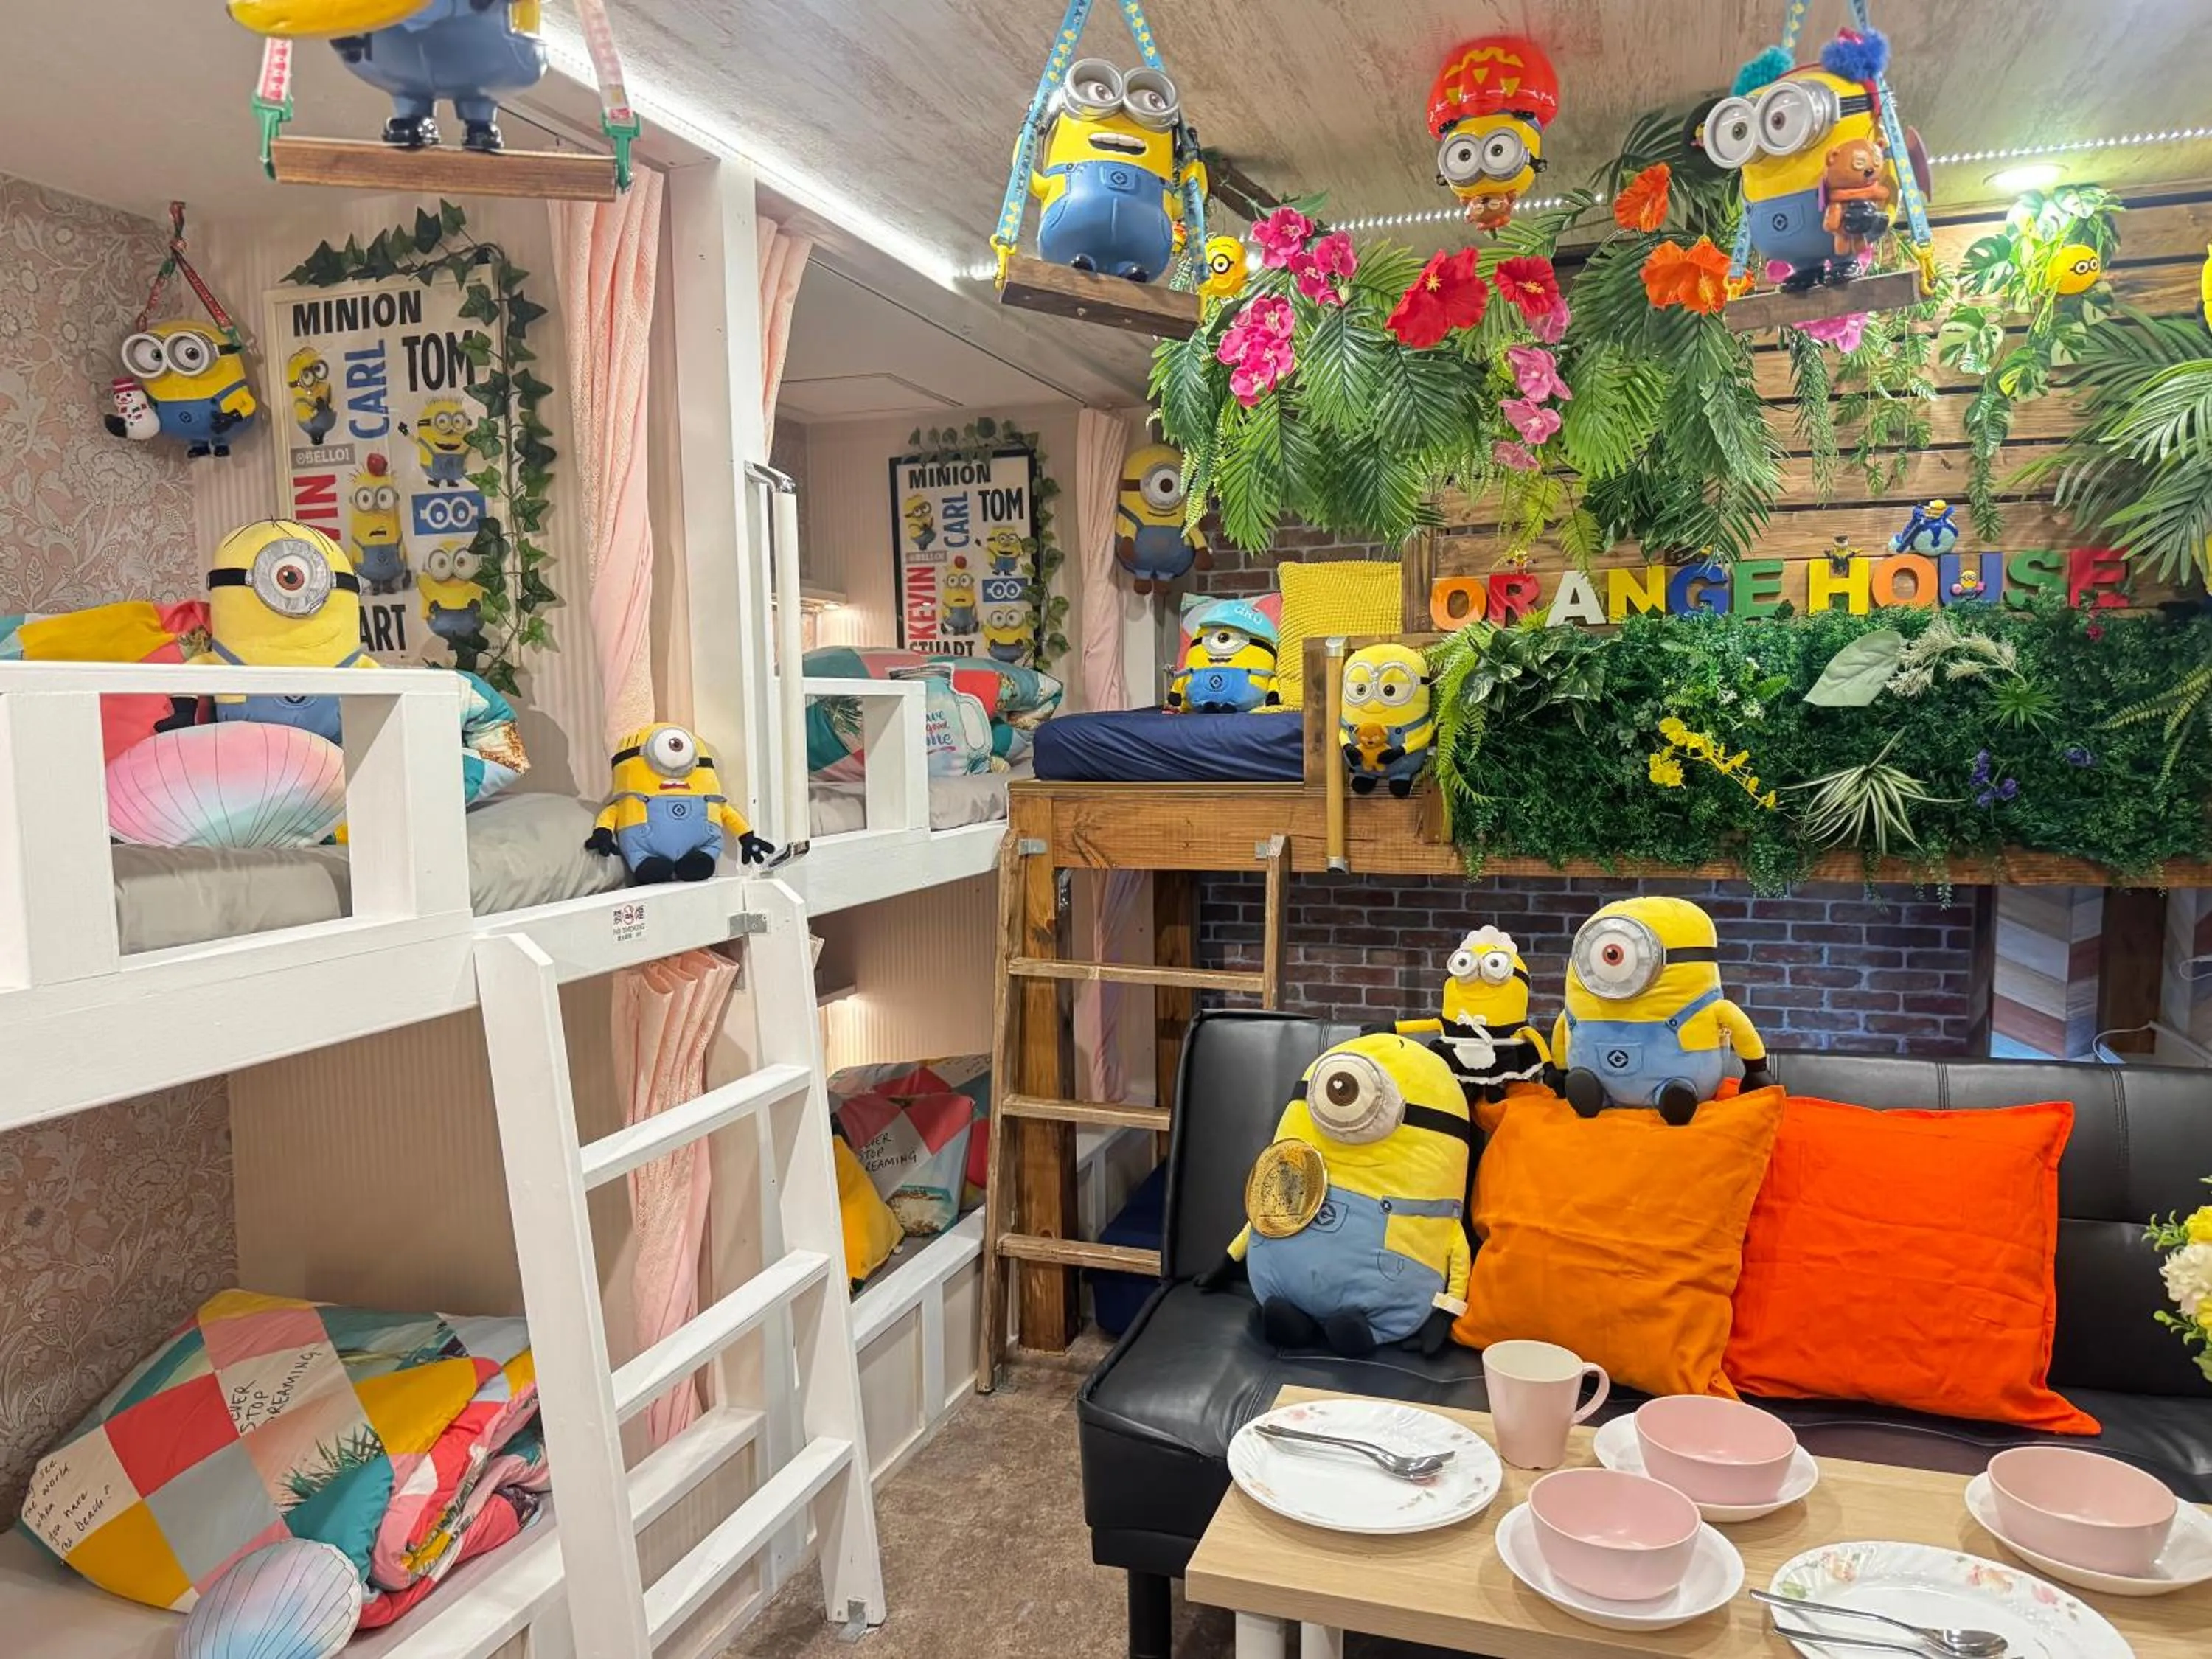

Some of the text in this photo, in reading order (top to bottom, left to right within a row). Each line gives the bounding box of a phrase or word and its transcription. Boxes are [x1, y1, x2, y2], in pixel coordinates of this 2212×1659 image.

[293, 290, 422, 337] MINION
[344, 339, 390, 439] CARL
[402, 330, 476, 392] TOM
[908, 464, 992, 489] MINION
[978, 487, 1024, 521] TOM
[942, 490, 970, 548] CARL
[906, 566, 937, 640] KEVIN
[1430, 547, 2132, 632] ORANGE HOUSE
[240, 1391, 269, 1433] STOP
